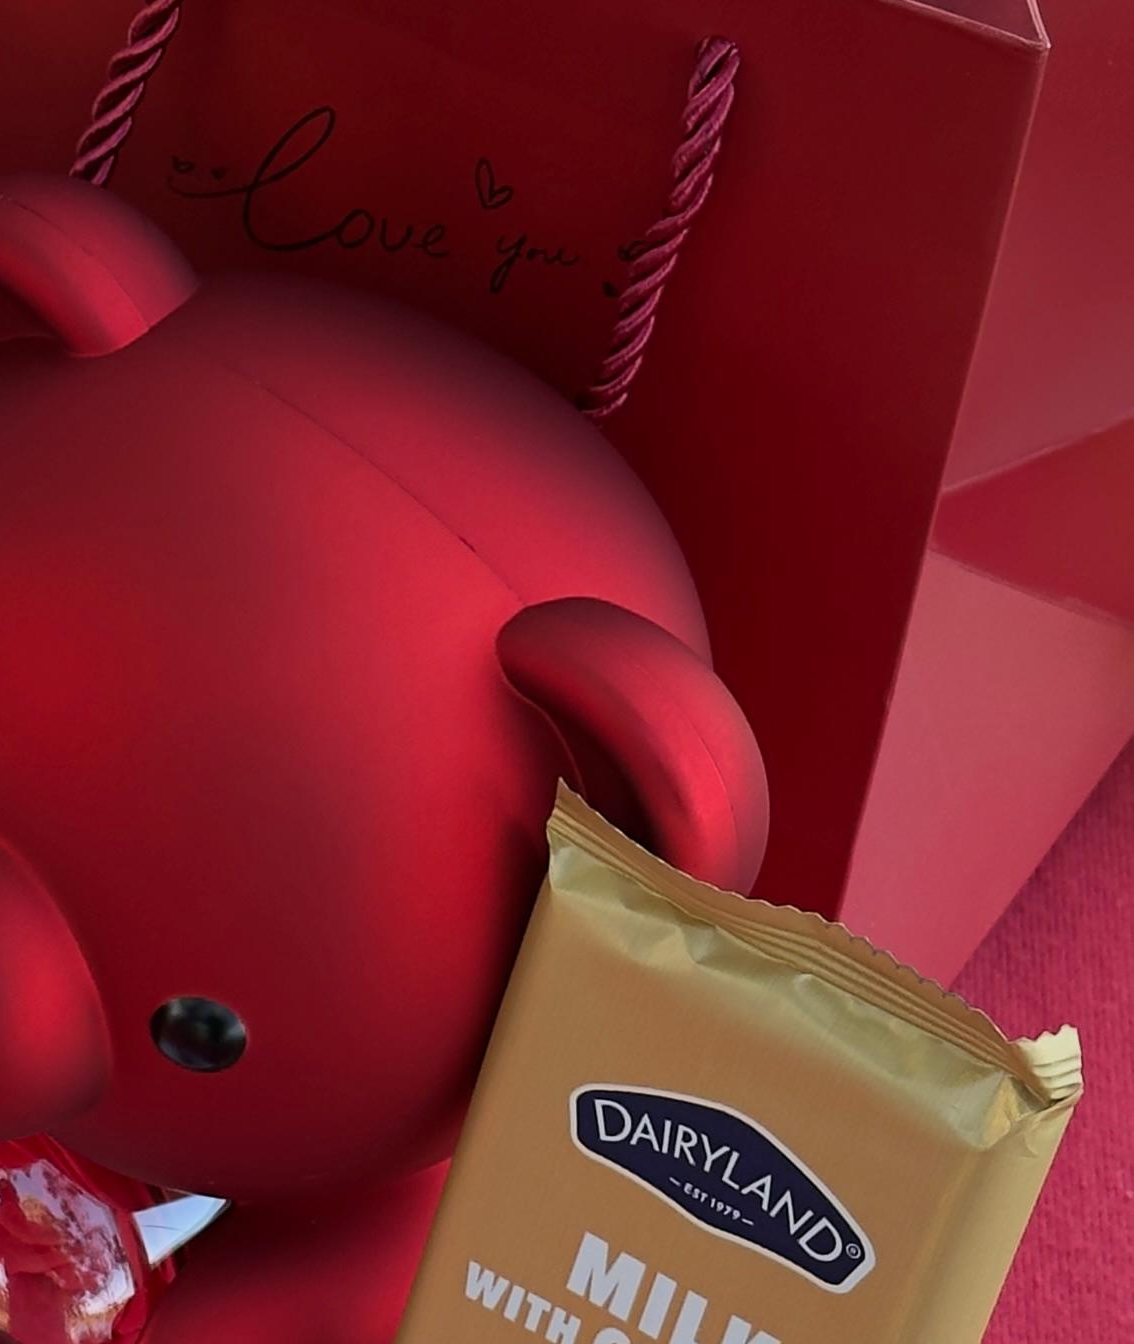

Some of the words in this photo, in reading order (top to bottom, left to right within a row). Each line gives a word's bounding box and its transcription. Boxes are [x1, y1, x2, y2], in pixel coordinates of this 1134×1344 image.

[490, 234, 580, 294] you
[594, 1099, 844, 1262] DAIRYLAND
[684, 1182, 708, 1203] EST
[710, 1197, 741, 1220] 1979
